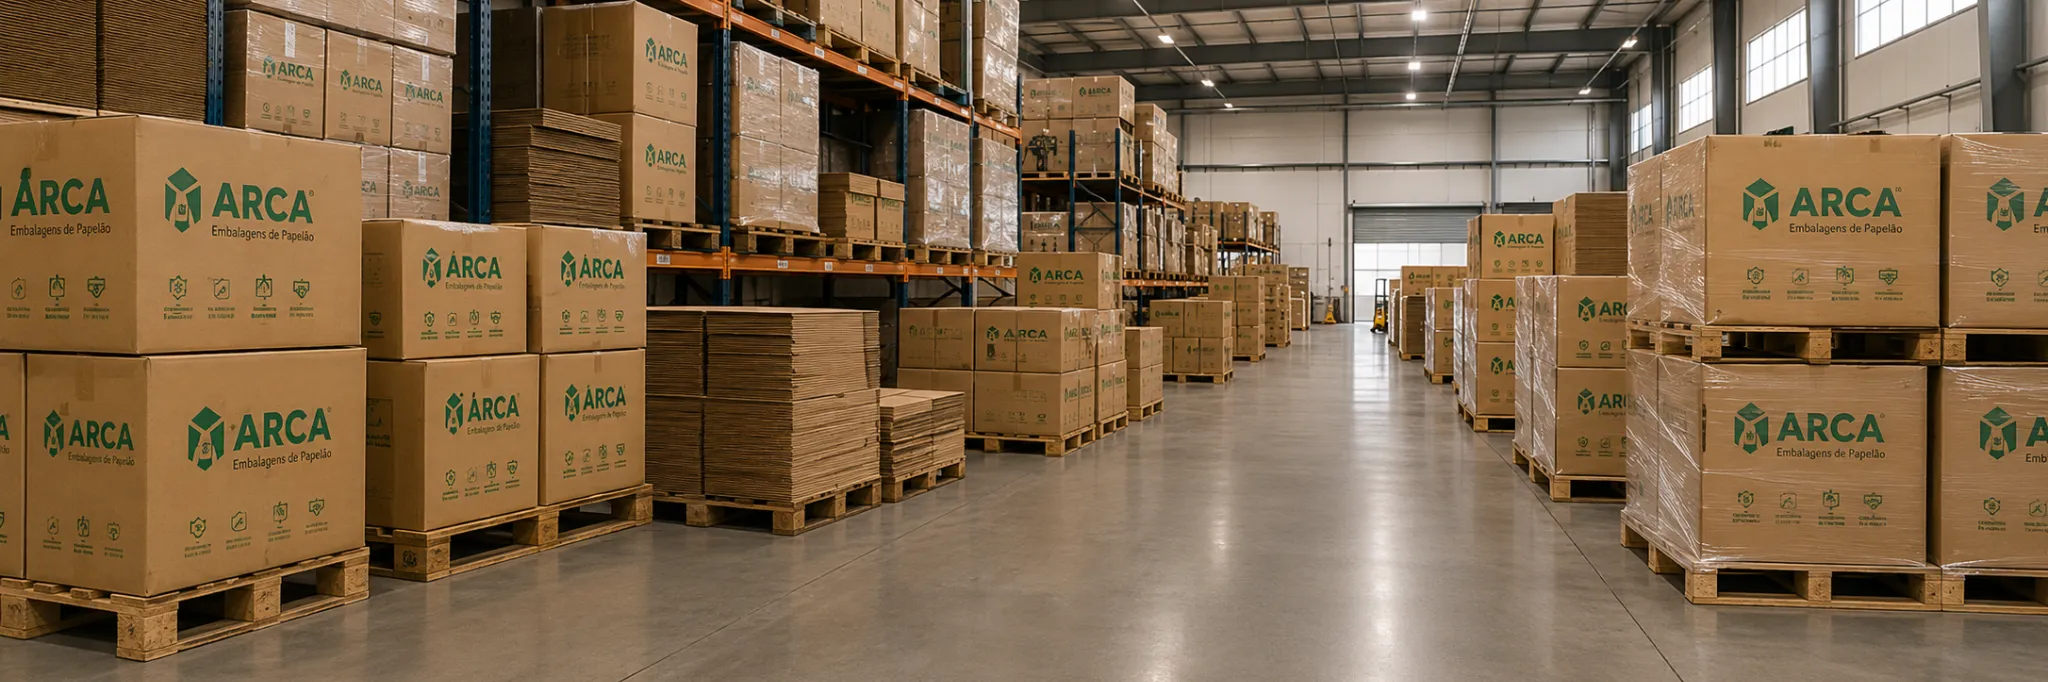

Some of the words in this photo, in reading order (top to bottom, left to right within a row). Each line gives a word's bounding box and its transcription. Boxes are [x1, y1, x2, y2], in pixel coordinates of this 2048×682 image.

[278, 61, 314, 82] ARCA
[352, 75, 383, 93] ARCA
[656, 149, 687, 168] ARCA
[11, 167, 111, 217] ÁRCA
[10, 224, 62, 239] Embalagens
[63, 223, 75, 235] de
[76, 222, 111, 237] Papelão
[211, 224, 267, 241] Embalagens
[268, 229, 280, 240] de
[281, 229, 315, 243] Papelão
[1789, 222, 1847, 236] Embalagens
[1849, 223, 1862, 233] de
[1864, 222, 1903, 236] Papelão
[1507, 233, 1545, 245] ARCA
[445, 250, 503, 279] ÁRCA
[1044, 269, 1084, 281] ARCA
[1599, 301, 1628, 317] AR
[68, 419, 135, 451] ARCA
[233, 456, 286, 470] Embalagens
[287, 451, 299, 463] de
[300, 448, 332, 463] Papelão
[1776, 447, 1832, 460] Embalagens
[1834, 448, 1846, 458] de
[1848, 448, 1886, 461] Papelão
